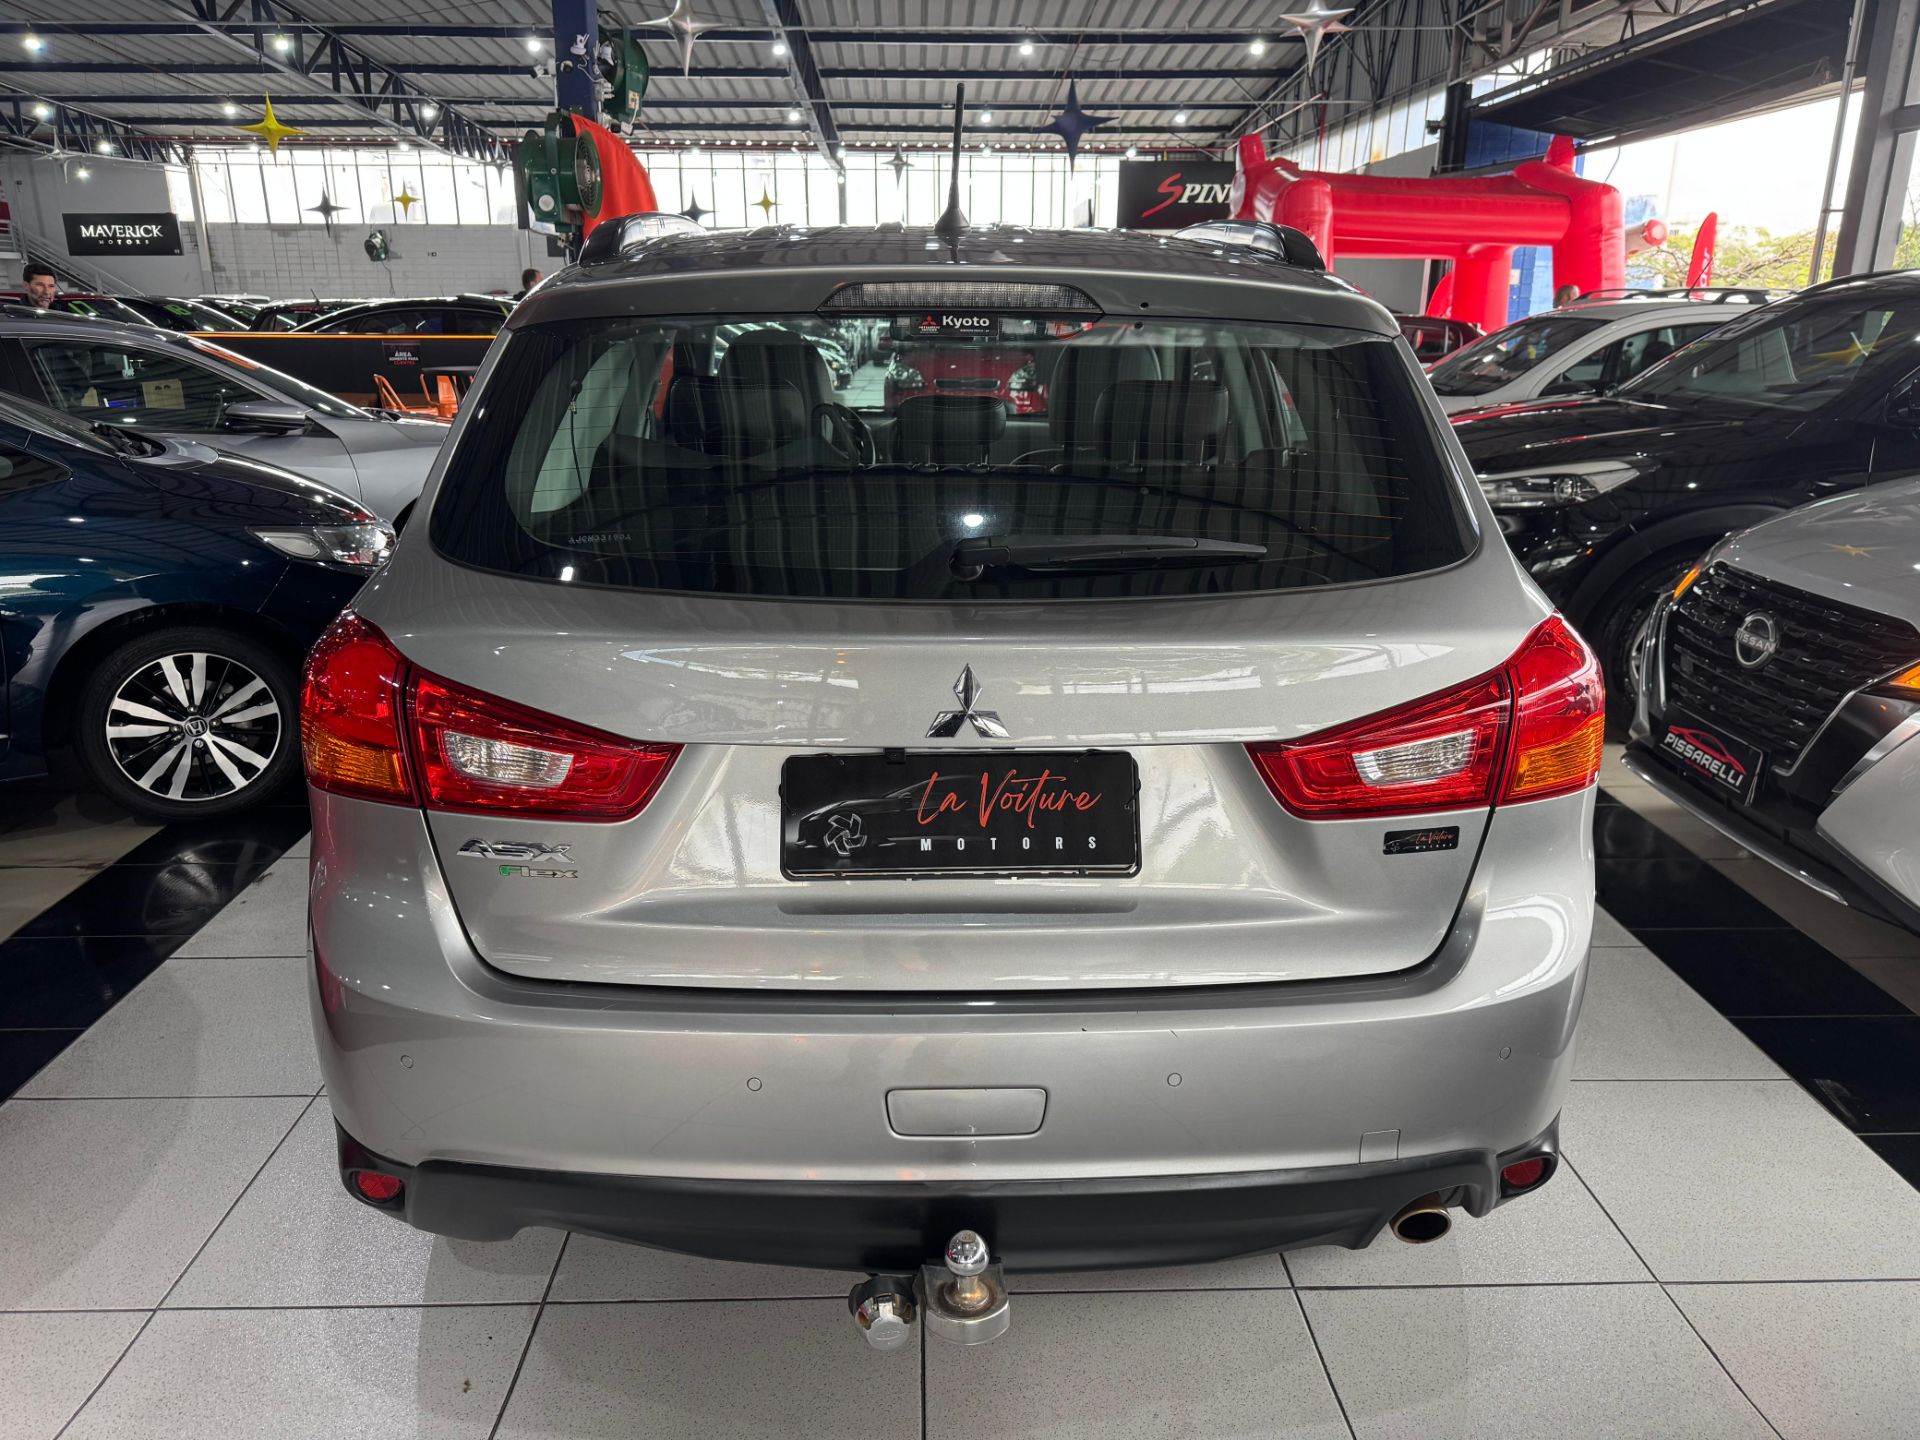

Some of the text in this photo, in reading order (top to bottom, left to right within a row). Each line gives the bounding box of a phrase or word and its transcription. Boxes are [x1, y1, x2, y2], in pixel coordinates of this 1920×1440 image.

[1141, 172, 1232, 218] SPIN
[80, 224, 163, 238] MAVERICK
[942, 315, 990, 328] Kyoto
[1735, 627, 1776, 653] NISSAN
[1664, 732, 1744, 787] PISSARELLI
[917, 769, 1102, 829] La Voiture
[456, 838, 575, 864] ASX
[920, 836, 1097, 852] MOTORS
